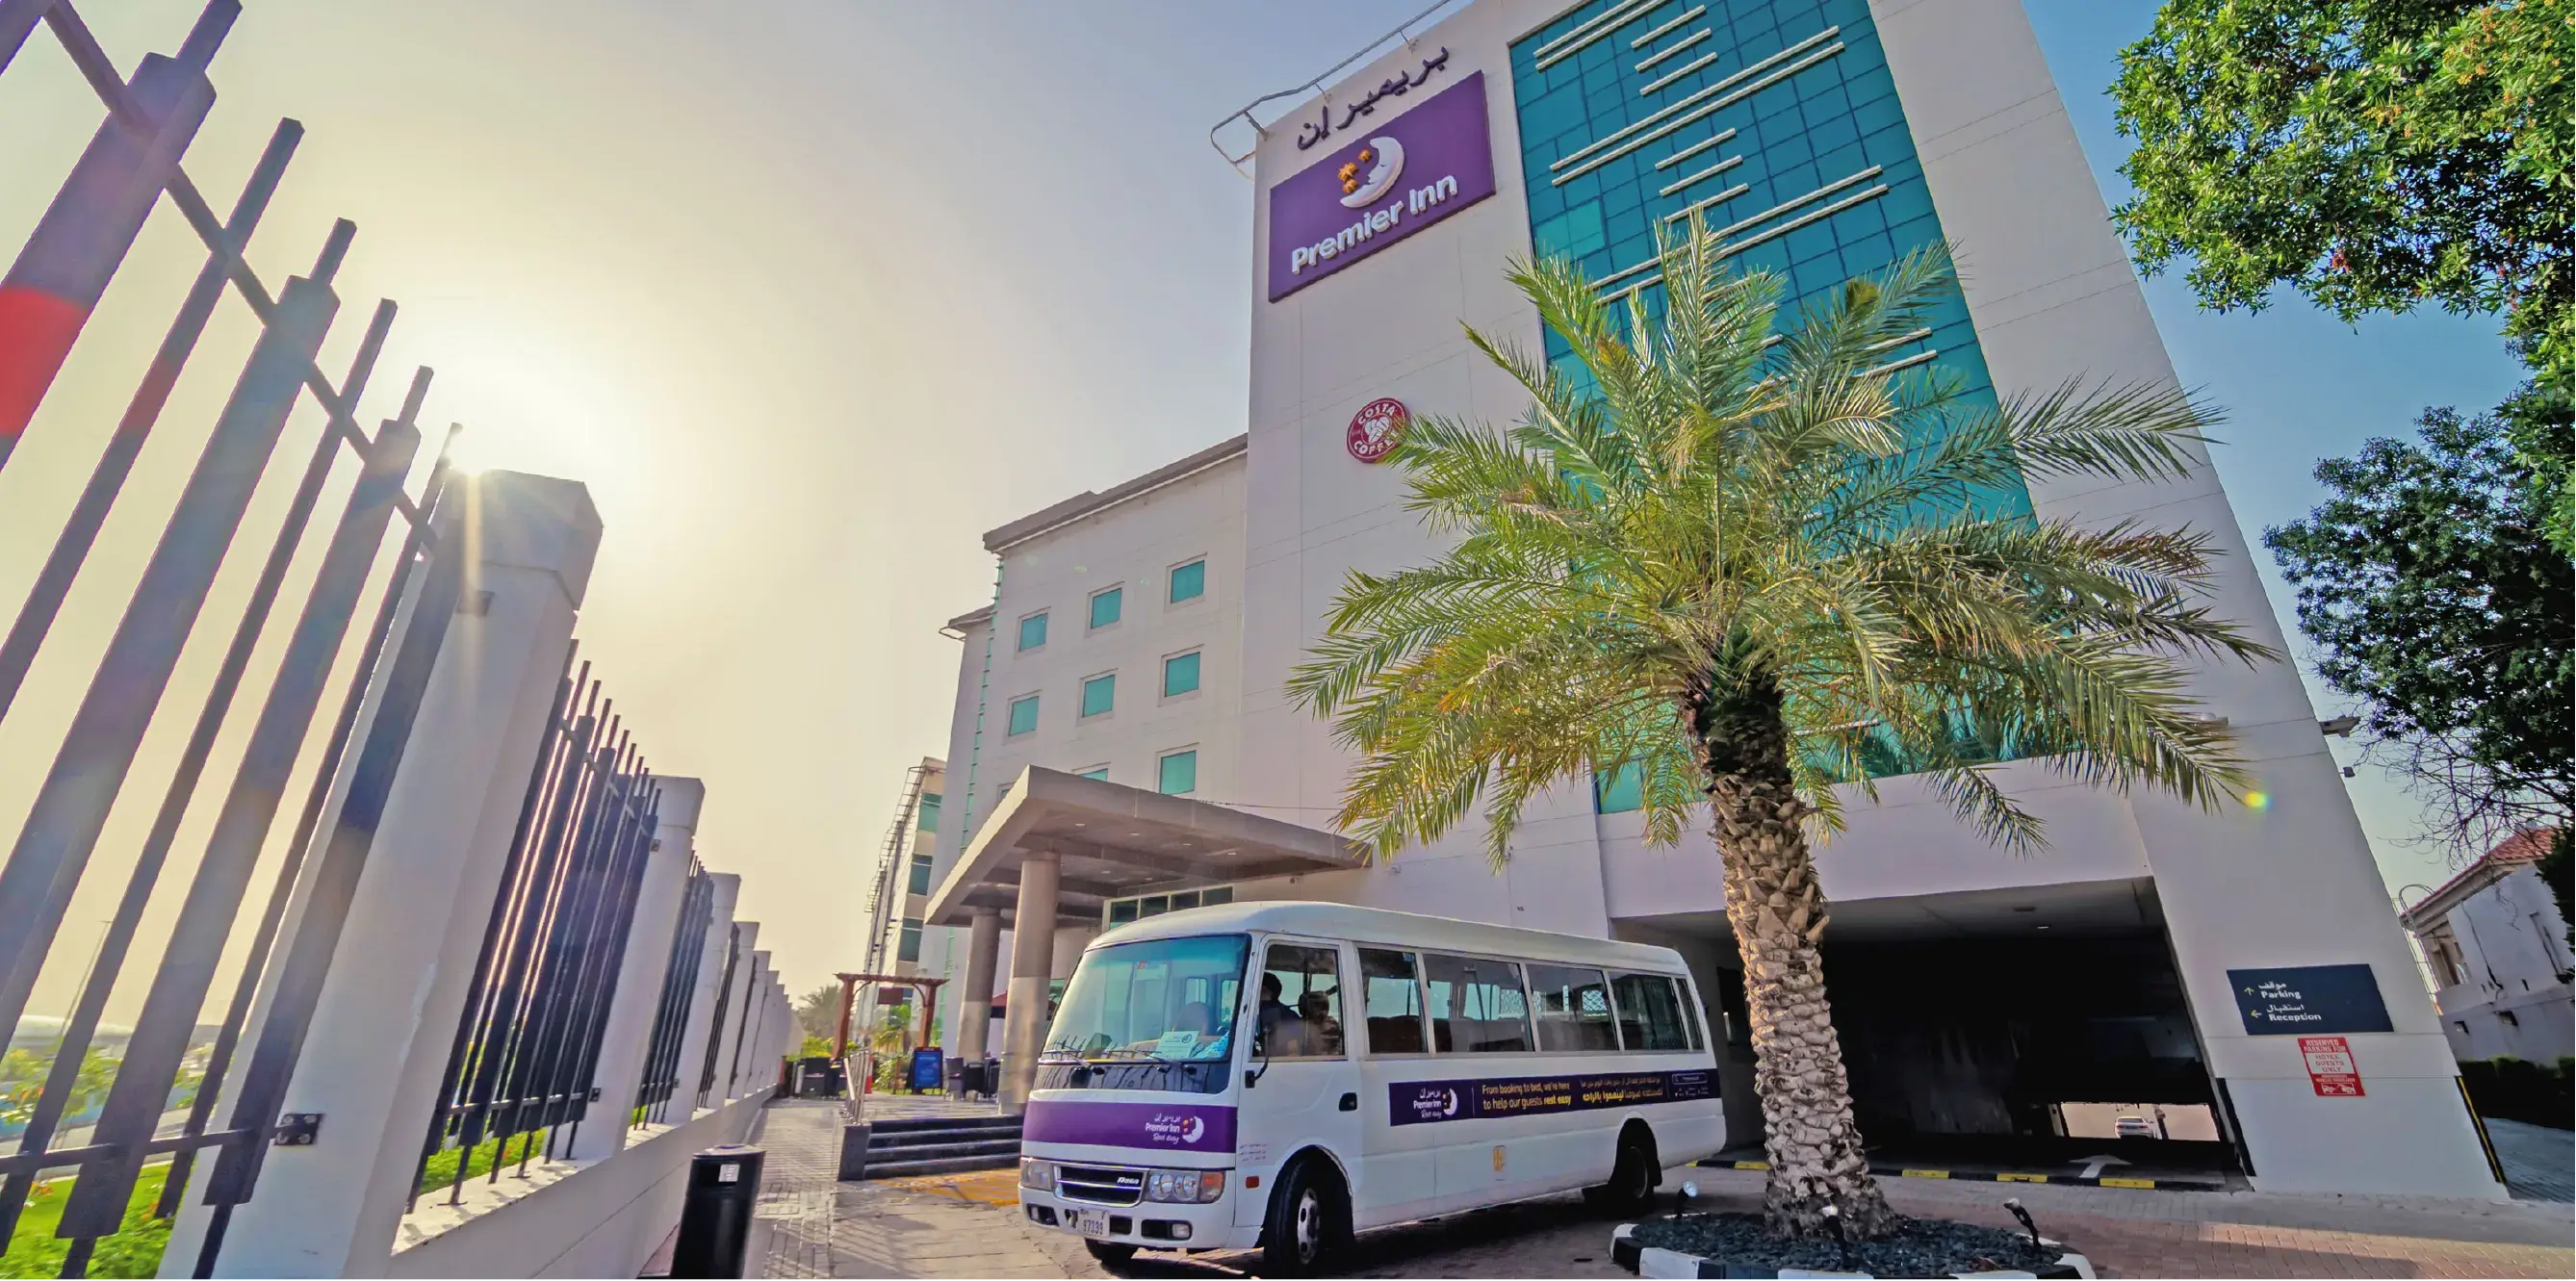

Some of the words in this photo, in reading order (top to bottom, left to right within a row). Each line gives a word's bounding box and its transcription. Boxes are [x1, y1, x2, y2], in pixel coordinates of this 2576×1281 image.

[1335, 45, 1449, 131] بريمير
[1291, 199, 1404, 275] Premier
[1409, 174, 1458, 217] Inn
[1357, 402, 1396, 425] COSTA
[2260, 990, 2302, 999] Parking
[2269, 1013, 2321, 1022] Reception
[1482, 1086, 1498, 1094] From
[1499, 1083, 1523, 1095] booking
[1413, 1100, 1433, 1109] Premier
[1483, 1100, 1491, 1110] to
[1492, 1097, 1507, 1111] help
[1508, 1098, 1521, 1109] our
[1521, 1096, 1543, 1110] guests
[1543, 1095, 1557, 1106] rest
[1557, 1095, 1572, 1106] easy
[1145, 1122, 1170, 1132] Premier
[1169, 1124, 1180, 1133] Inn
[1117, 1176, 1140, 1185] Rosa
